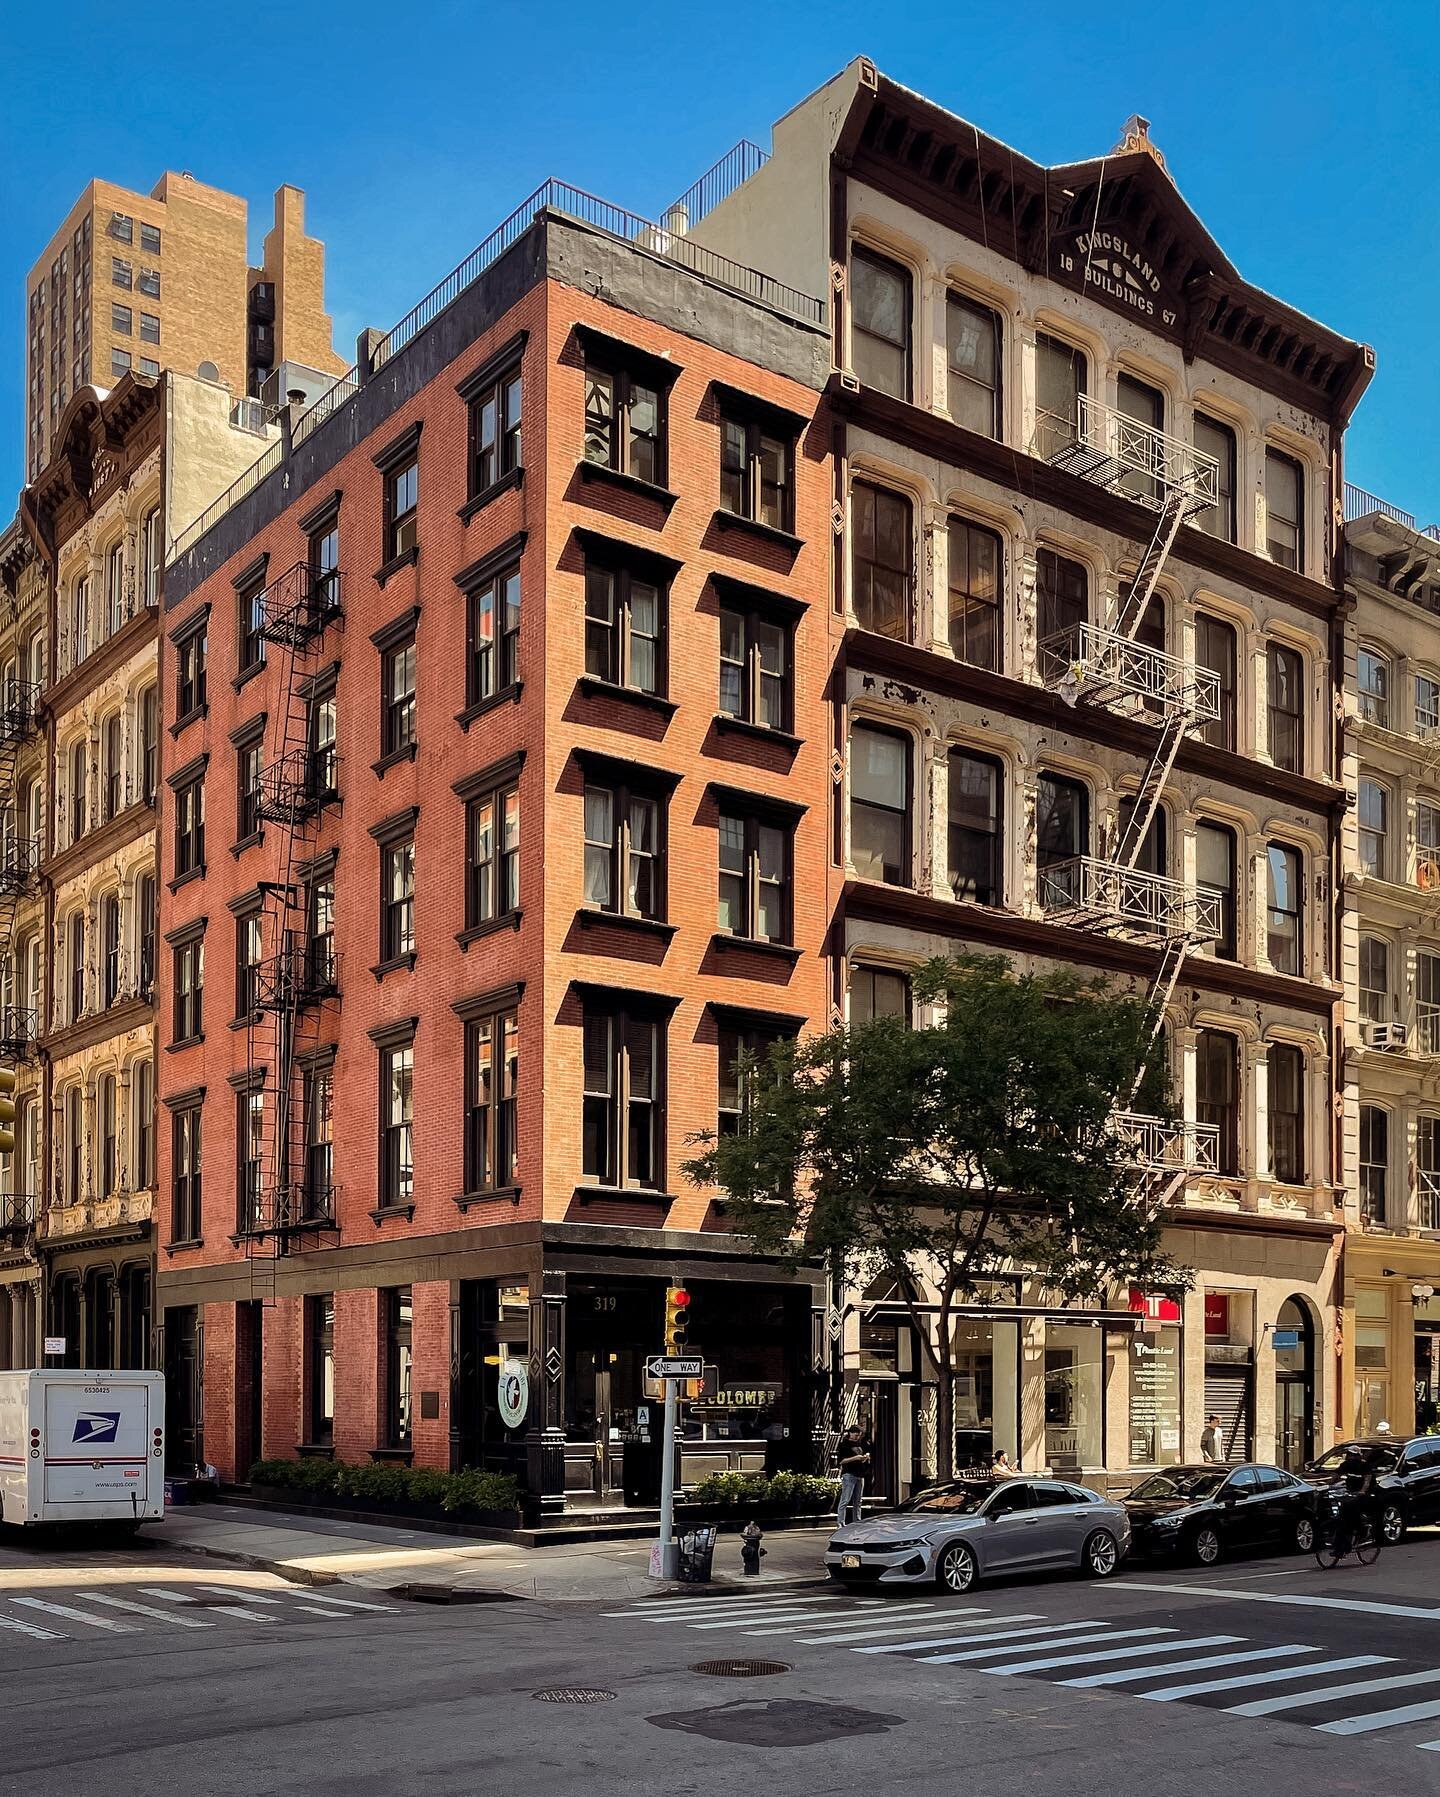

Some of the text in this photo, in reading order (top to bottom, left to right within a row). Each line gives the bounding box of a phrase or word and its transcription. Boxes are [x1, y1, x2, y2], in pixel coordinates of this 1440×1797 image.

[1060, 253, 1073, 272] 18
[1076, 232, 1161, 293] KINGSLAND
[1084, 266, 1154, 315] BUILDINGS
[1162, 309, 1177, 326] 67
[594, 1296, 616, 1311] 319
[654, 1363, 698, 1372] ONE WAY
[639, 1409, 647, 1420] A
